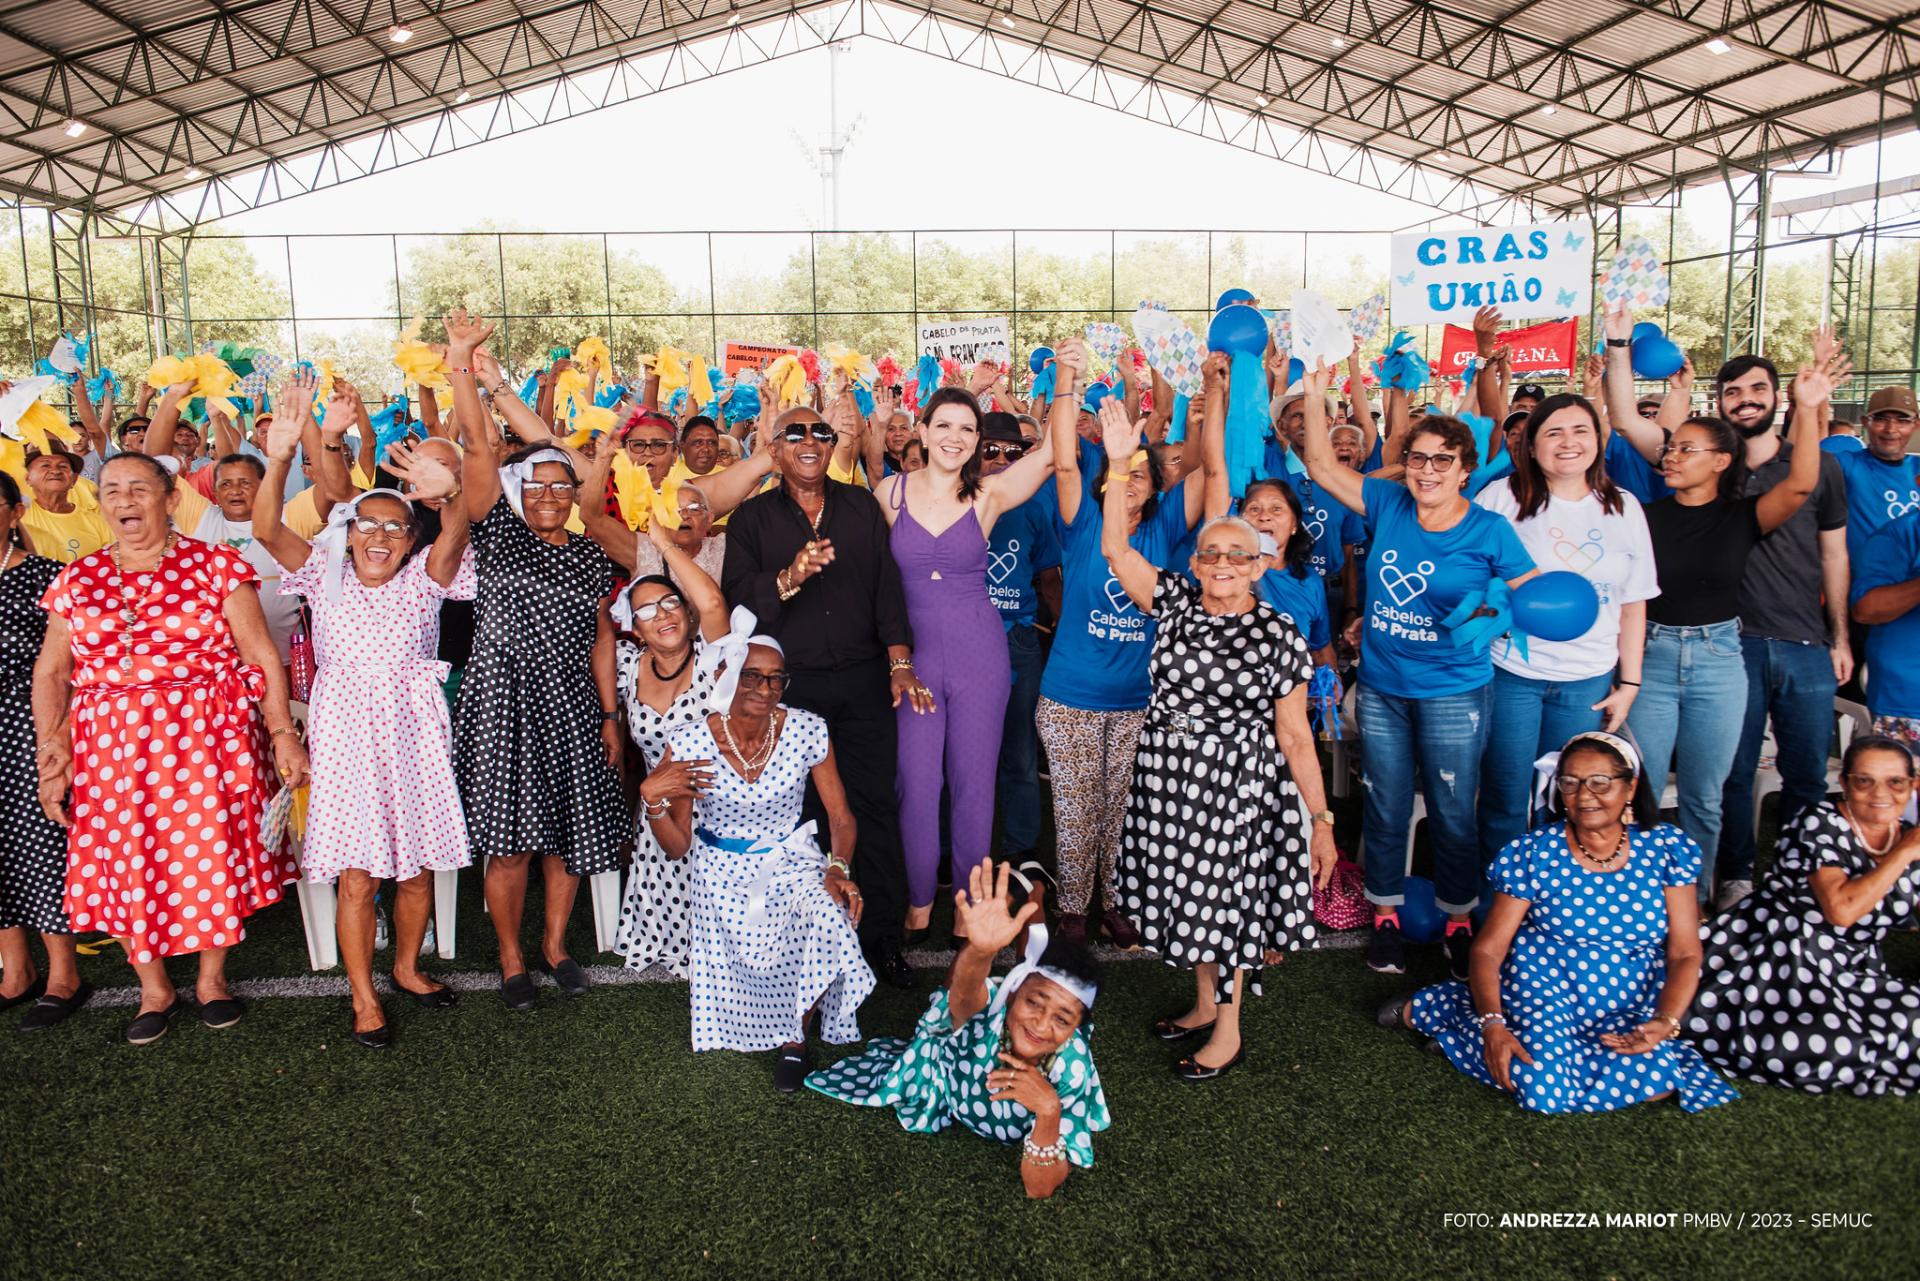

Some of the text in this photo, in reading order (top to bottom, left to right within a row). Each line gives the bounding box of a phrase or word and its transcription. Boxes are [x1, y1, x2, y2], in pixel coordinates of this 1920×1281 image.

[1417, 231, 1548, 266] CRAS
[1426, 272, 1542, 311] UNIÃO
[922, 327, 957, 340] CABELO
[971, 326, 1001, 337] PRATA
[727, 354, 757, 362] CABELOS
[738, 344, 787, 354] CAMPEONATO
[985, 584, 1021, 598] belos
[1090, 609, 1146, 628] Cabelos
[1373, 600, 1433, 627] Cabelos
[1088, 621, 1146, 642] De Prata
[1371, 614, 1438, 642] De Prata
